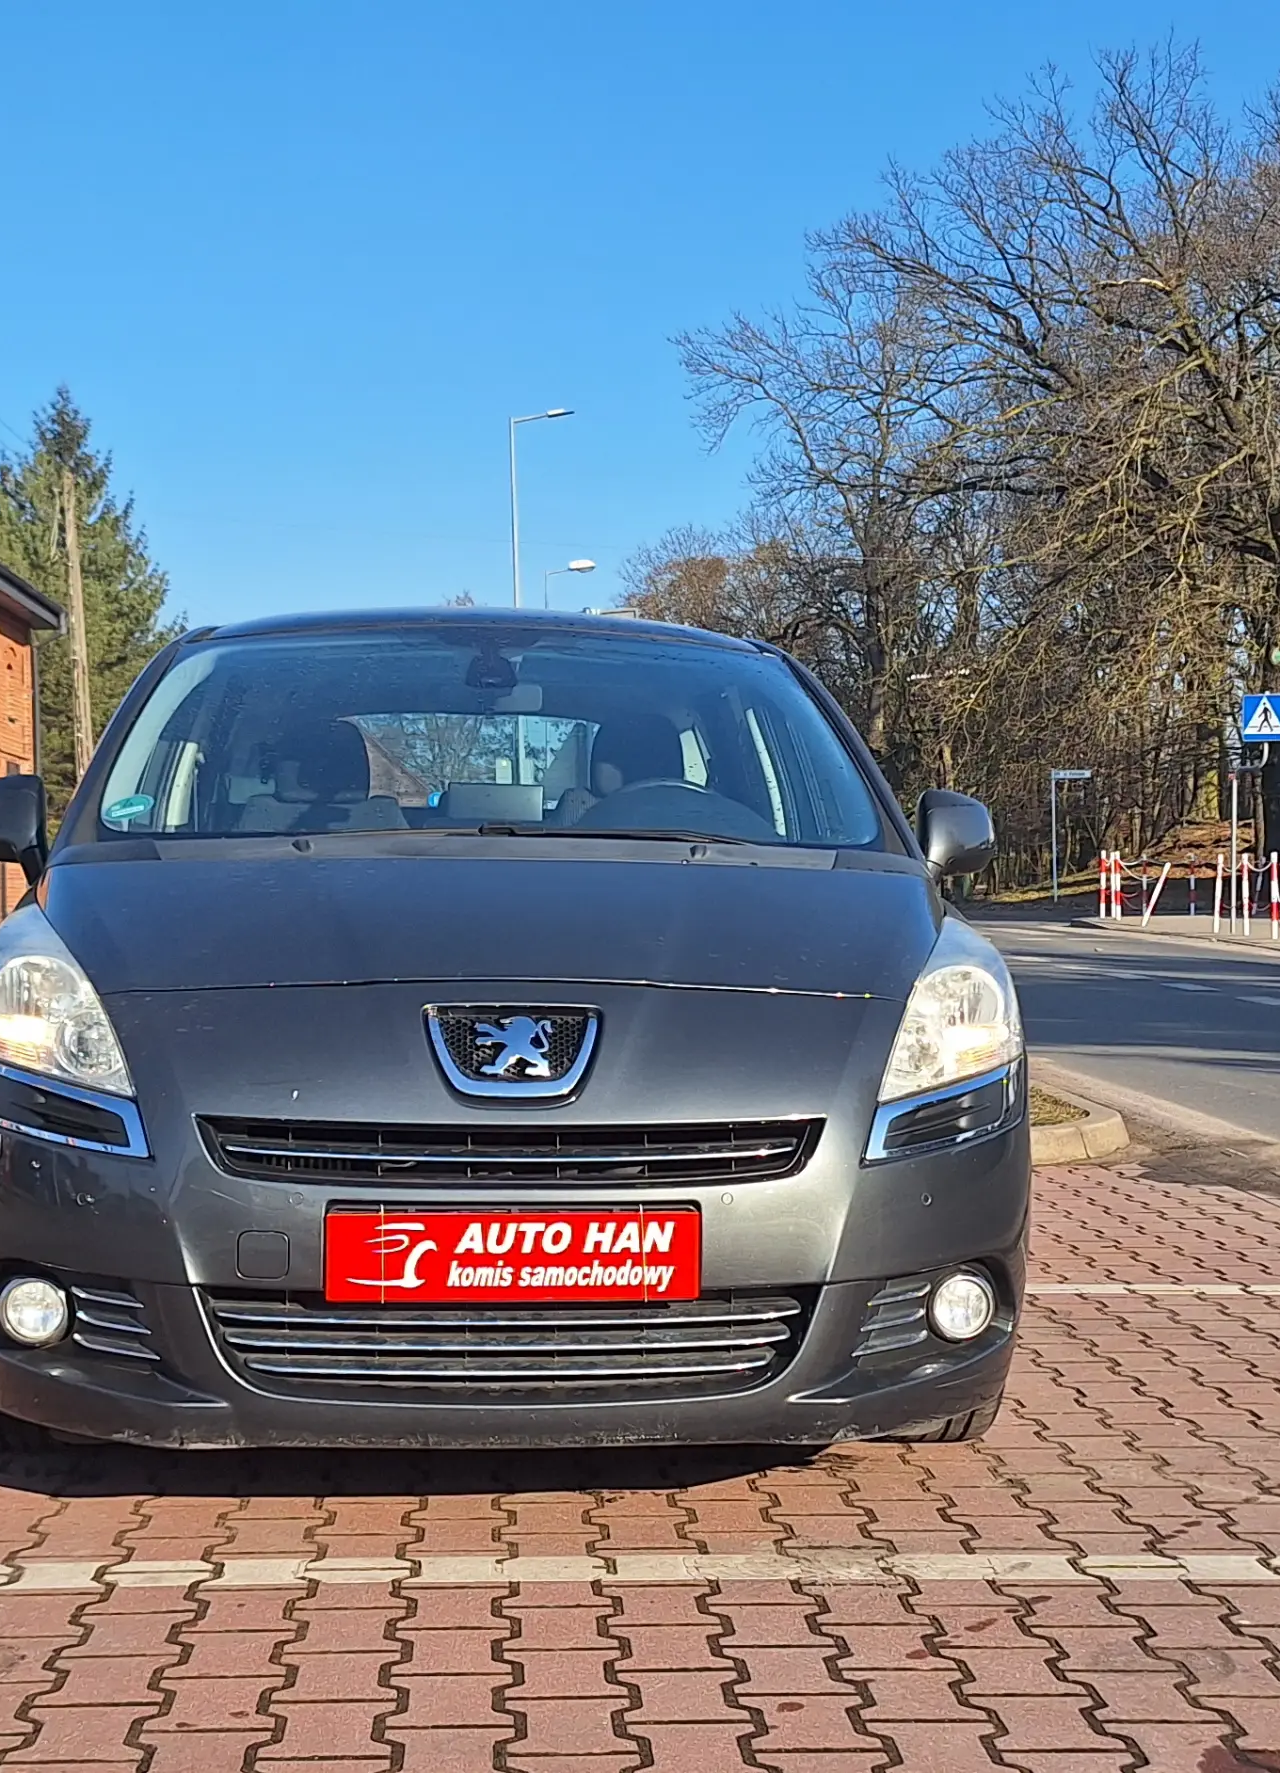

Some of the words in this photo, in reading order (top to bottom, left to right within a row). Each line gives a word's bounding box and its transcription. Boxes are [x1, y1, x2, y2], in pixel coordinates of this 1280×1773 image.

[455, 1222, 572, 1254] AUTO
[583, 1222, 675, 1253] HAN
[447, 1260, 513, 1287] komis
[518, 1260, 674, 1292] samochodowy
